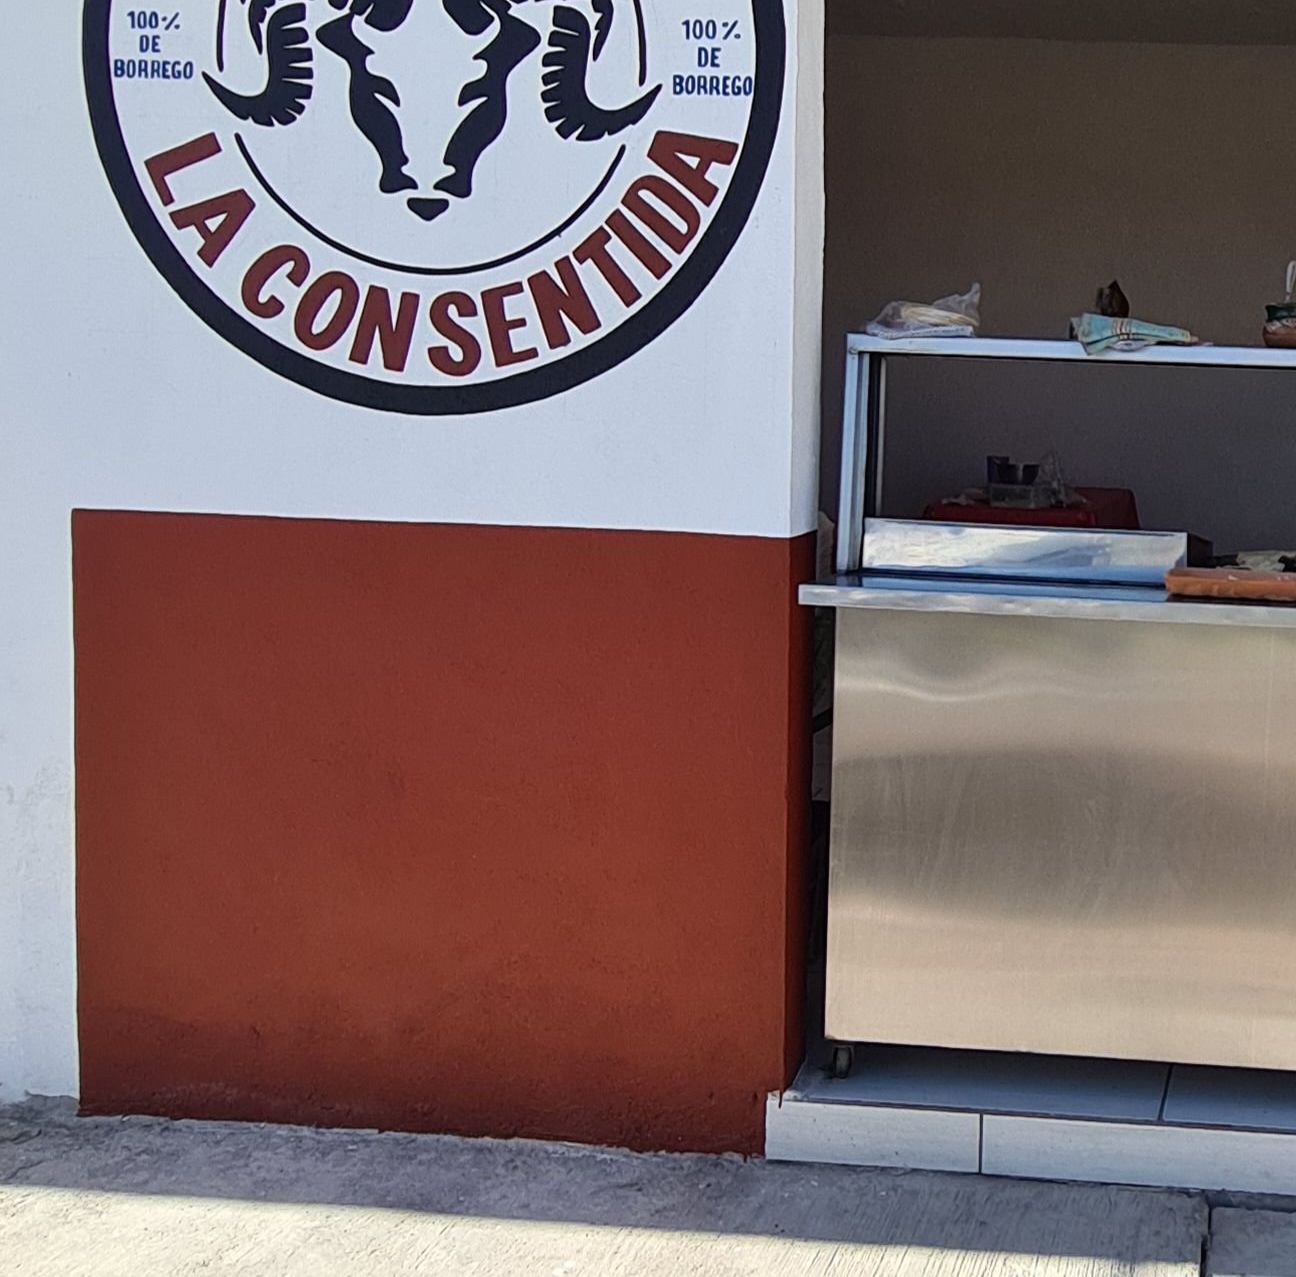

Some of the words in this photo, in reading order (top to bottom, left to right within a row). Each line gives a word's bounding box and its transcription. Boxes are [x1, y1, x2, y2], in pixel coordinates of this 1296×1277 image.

[127, 10, 180, 31] 100%
[681, 19, 741, 40] 100%
[139, 35, 161, 53] DE
[697, 47, 721, 68] DE
[114, 59, 194, 79] BORREGO
[672, 74, 753, 96] BORREGO
[143, 131, 257, 269] LA
[240, 129, 740, 378] CONSENTIDA
